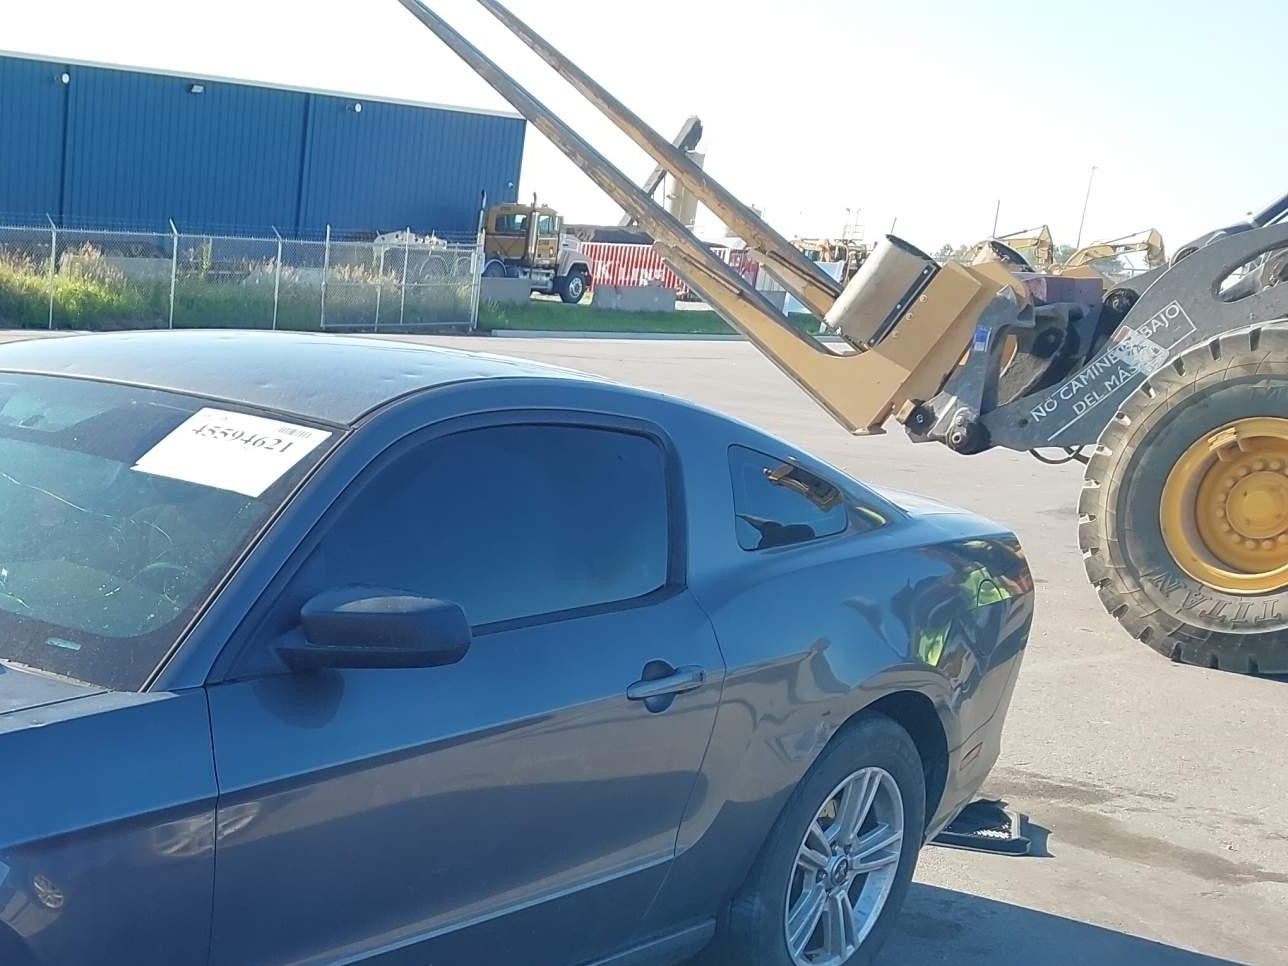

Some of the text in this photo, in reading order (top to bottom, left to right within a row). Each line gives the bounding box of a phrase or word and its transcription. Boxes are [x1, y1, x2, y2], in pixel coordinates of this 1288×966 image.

[1030, 398, 1058, 422] NO
[1060, 351, 1123, 400] CAMINE
[1072, 391, 1105, 416] DEL
[192, 424, 294, 453] 45594621
